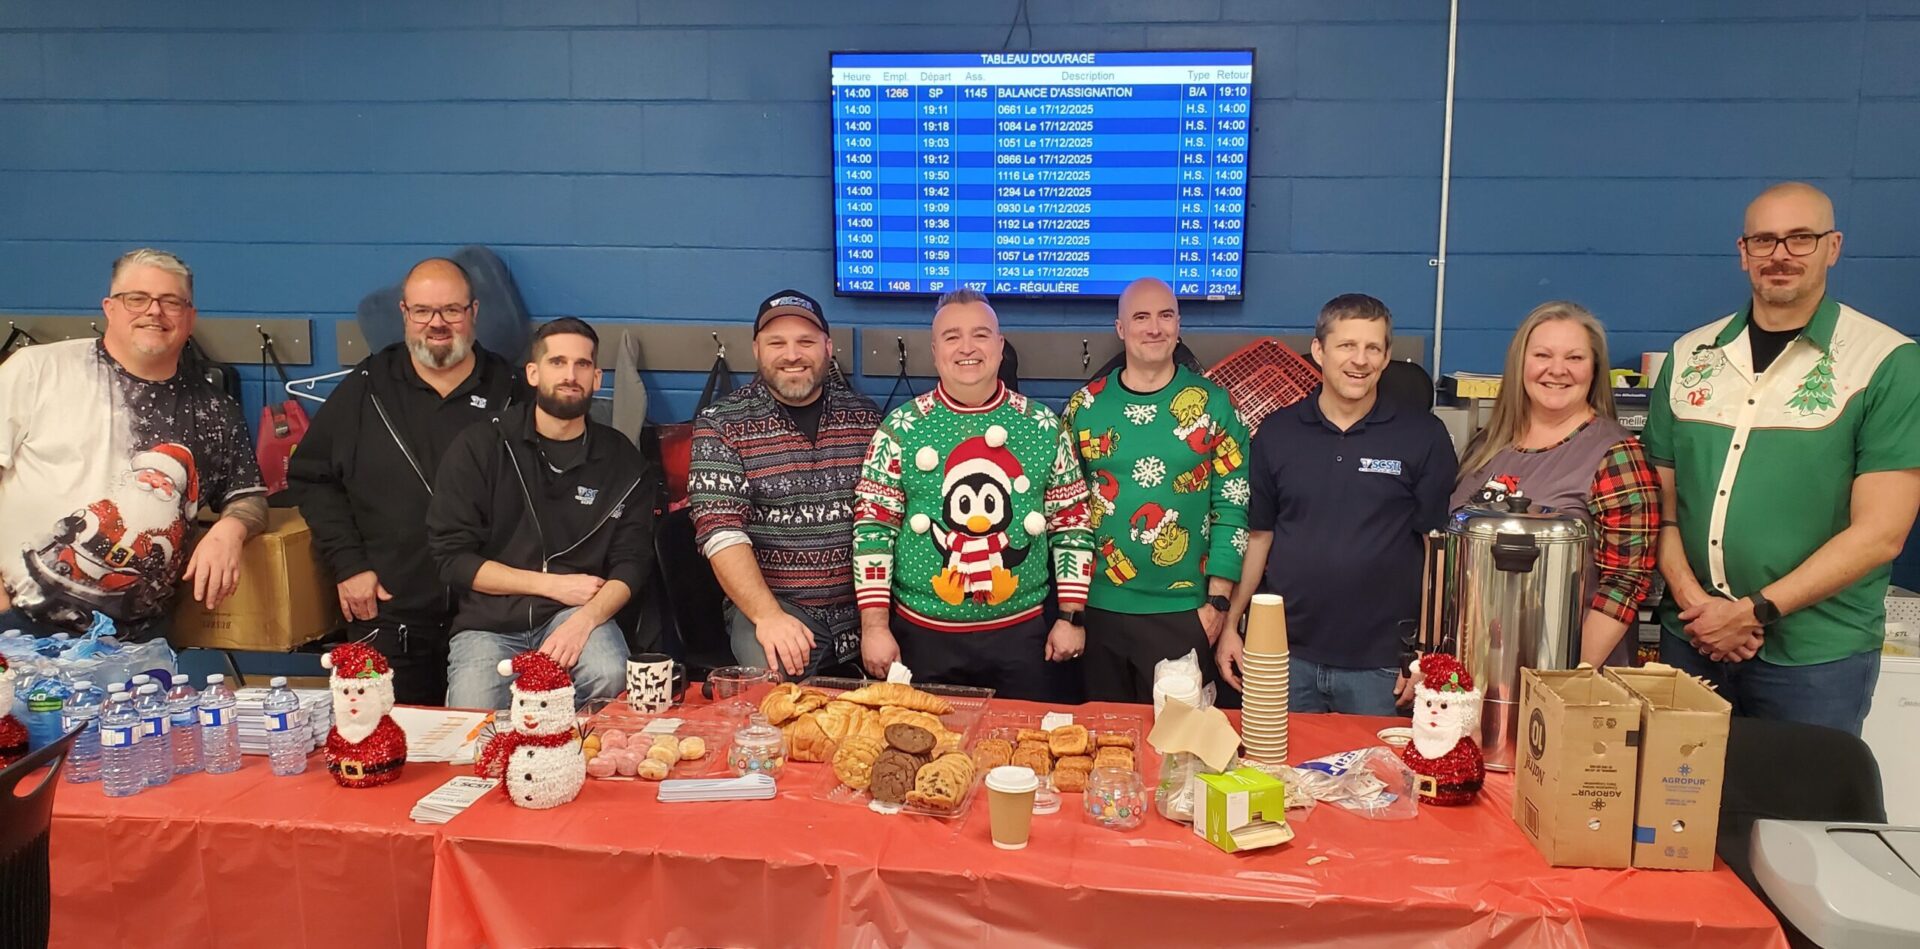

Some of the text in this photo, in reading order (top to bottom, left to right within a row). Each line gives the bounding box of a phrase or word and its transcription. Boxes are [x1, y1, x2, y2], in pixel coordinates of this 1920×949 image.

[981, 53, 1095, 64] TABLEAU D'OUVRAGE
[843, 70, 1250, 84] Heure Empl. Départ Ass. Description Type Retour
[845, 87, 1247, 98] 14:00 1266 SP 1145 BALANCE D'ASSIGNATION B/A 19:10
[845, 104, 1246, 114] 14:00 19:11 0661 Le 17/12/2025 H.S. 14:00
[845, 120, 1245, 131] 14:00 19:18 1084 Le 17/12/2025 H.S. 14:00
[846, 137, 1244, 147] 14:00 19:03 1051 Le 17/12/2025 H.S. 14:00
[846, 154, 1244, 164] 14:00 19:12 0866 Le 17/12/2025 H.S. 14:00
[847, 170, 1243, 180] 14:00 19:50 1116 Le 17/12/2025 H.S. 14:00
[847, 186, 1242, 197] 14:00 19:42 1294 Le 17/12/2025 H.S. 14:00
[847, 203, 1241, 213] 14:00 19:09 0930 Le 17/12/2025 H.S. 14:00
[848, 218, 1240, 229] 14:00 19:36 1192 Le 17/12/2025 H.S. 14:00
[848, 234, 1239, 245] 14:00 19:02 0940 Le 17/12/2025 H.S. 14:00
[848, 250, 1239, 261] 14:00 19:59 1057 Le 17/12/2025 H.S. 14:00
[849, 265, 1238, 277] 14:00 19:35 1243 Le 17/12/2025 H.S. 14:00
[849, 281, 874, 290] 14:02
[889, 282, 910, 291] 1408
[930, 282, 943, 291] SP
[996, 284, 1011, 292] AC
[1180, 284, 1198, 293] A/C
[1532, 723, 1544, 752] 10
[1662, 776, 1706, 785] AGROPUR
[1578, 790, 1622, 798] AGROPUR
